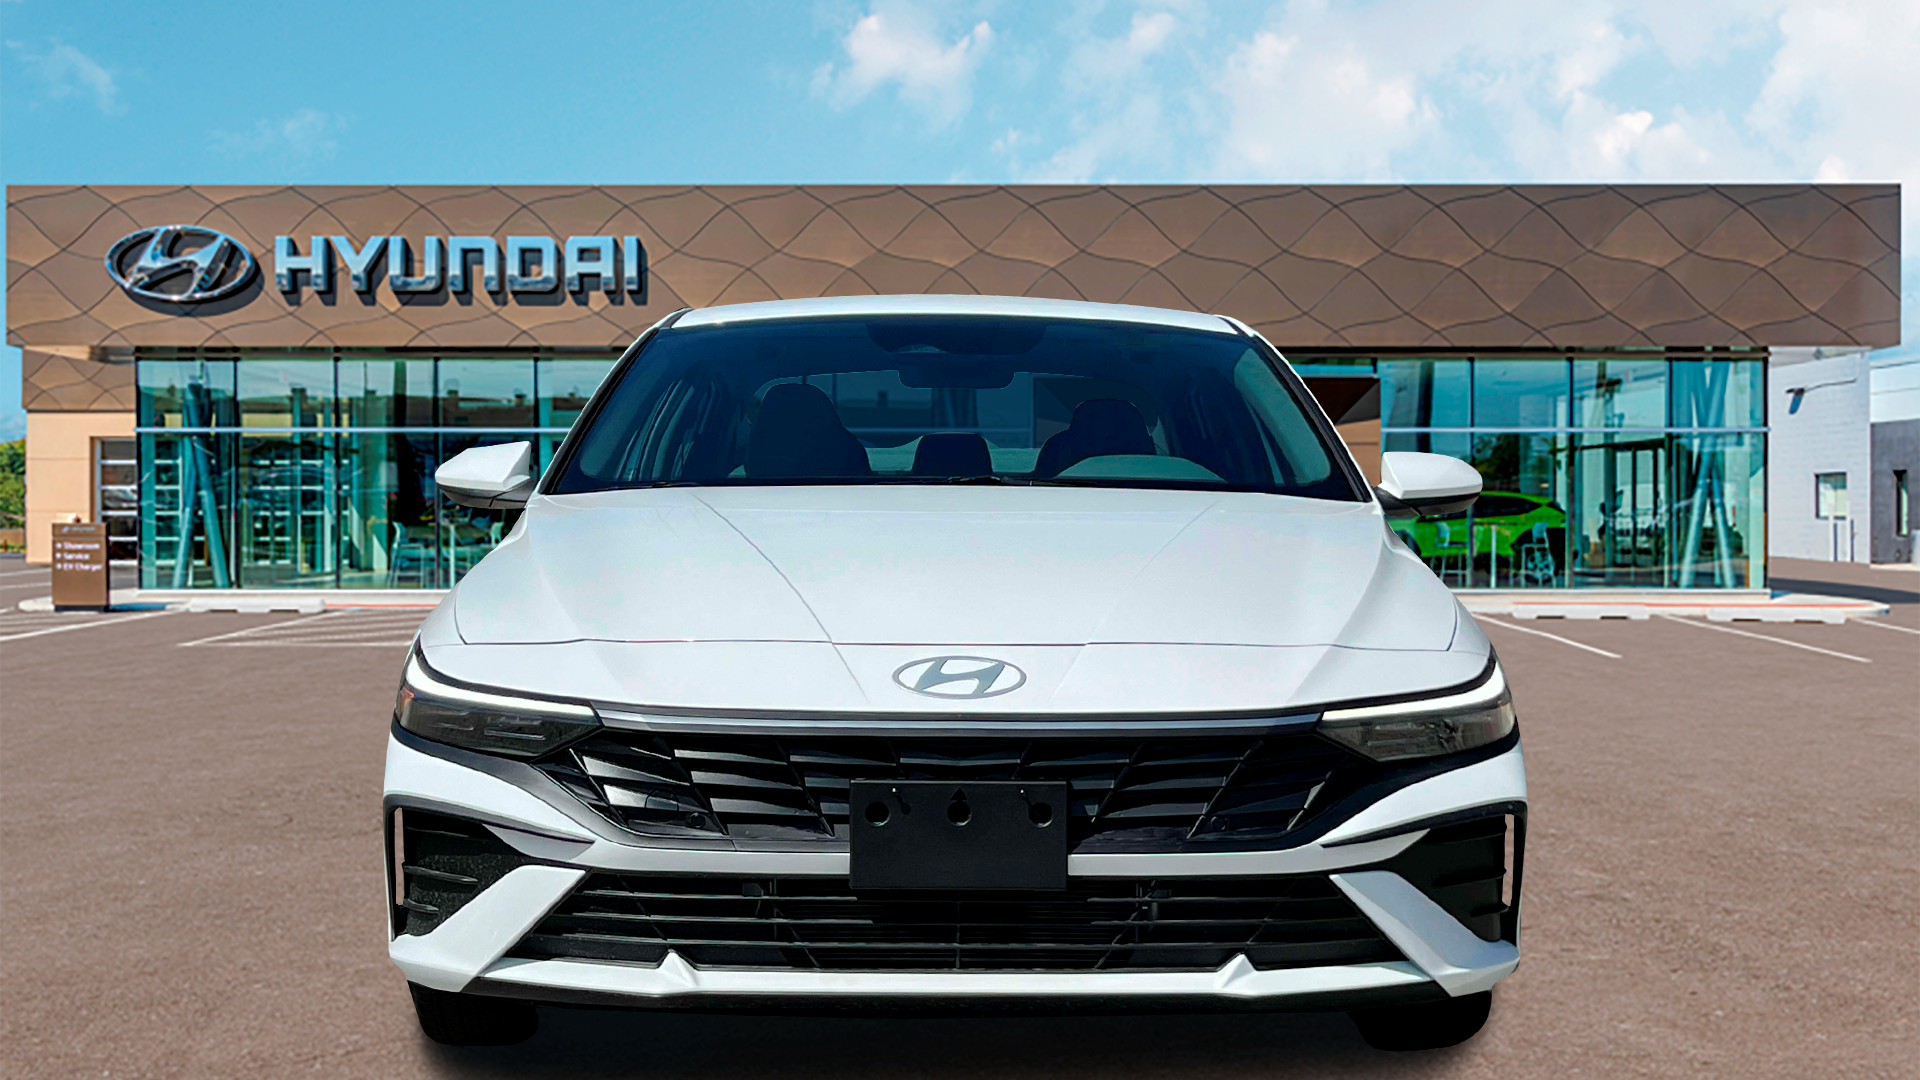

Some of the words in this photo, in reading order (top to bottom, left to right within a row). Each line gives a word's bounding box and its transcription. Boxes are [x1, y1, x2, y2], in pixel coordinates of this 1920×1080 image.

[274, 235, 641, 294] HYUNDAI
[63, 542, 100, 550] Showroom
[63, 552, 90, 560] Service
[75, 562, 102, 572] Charger
